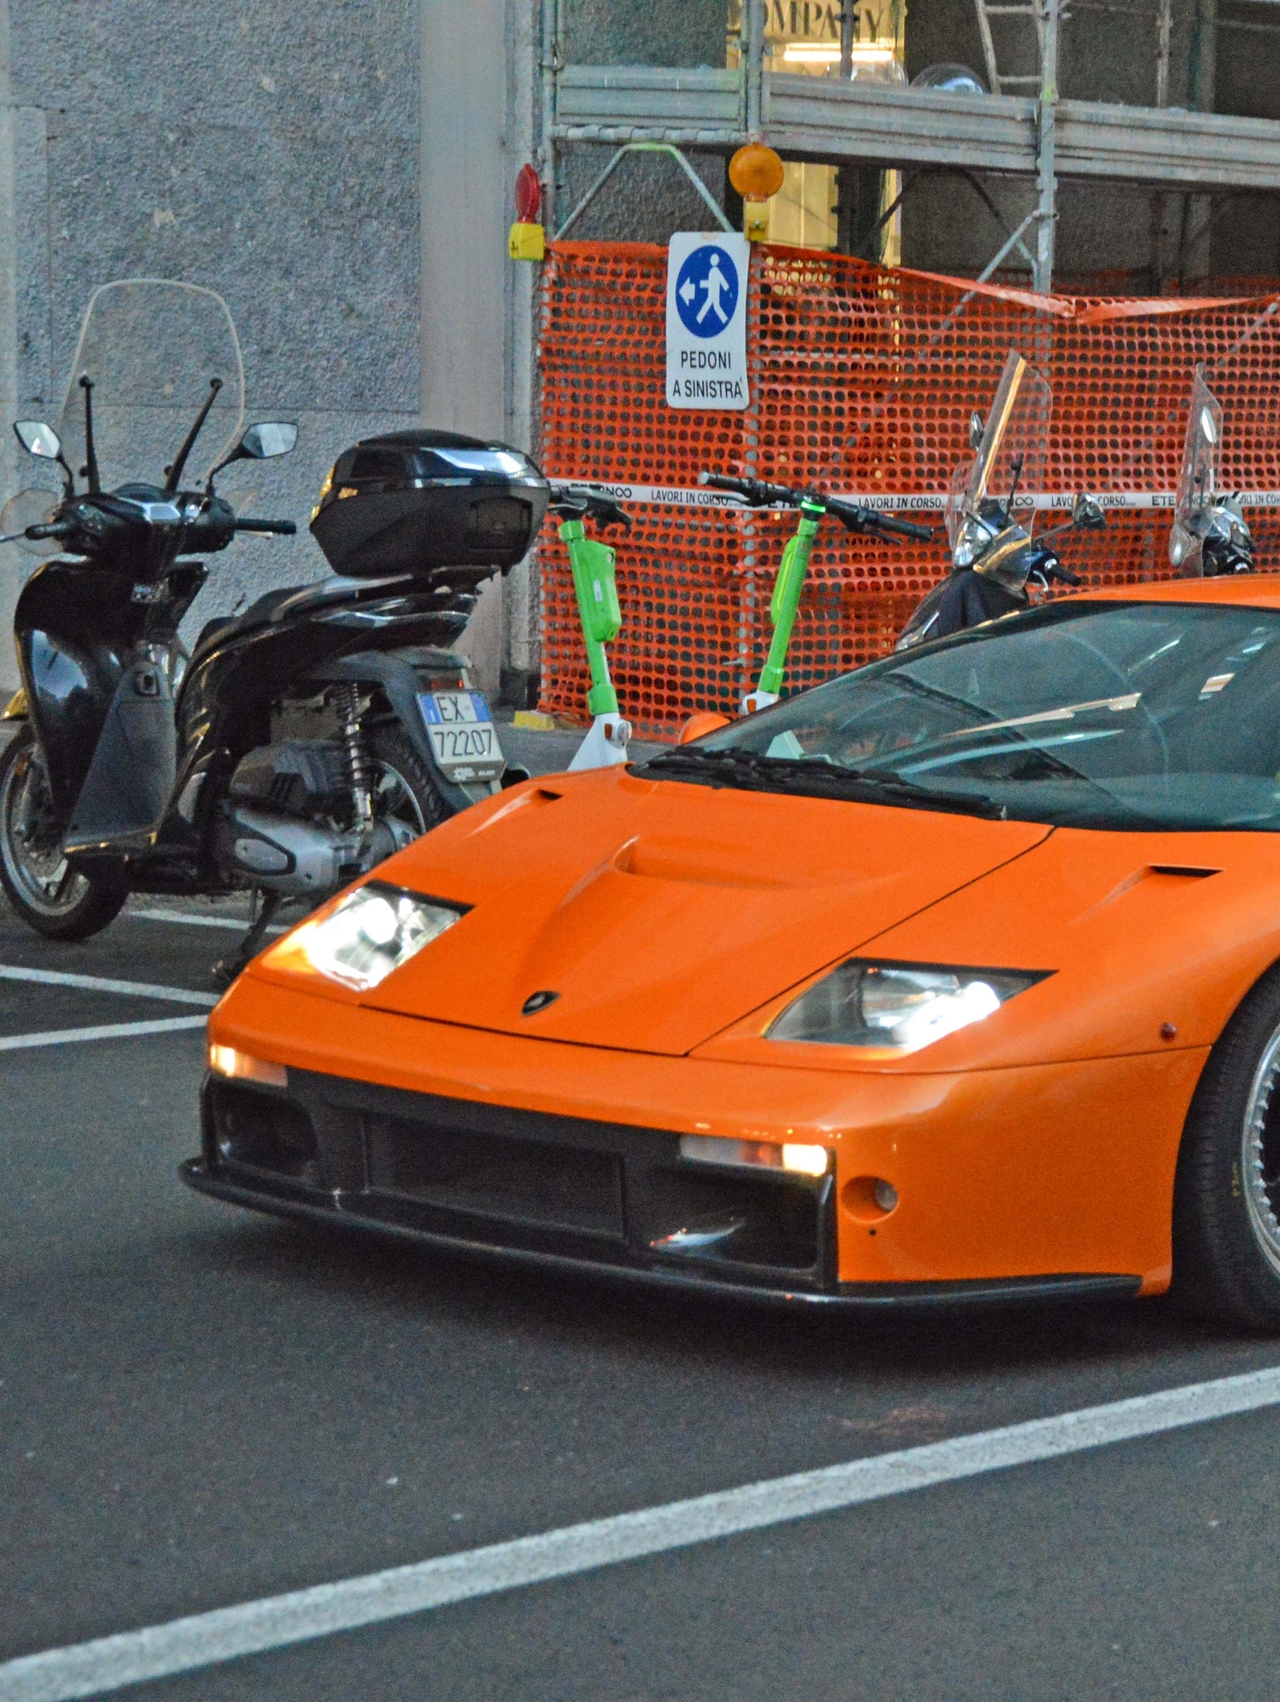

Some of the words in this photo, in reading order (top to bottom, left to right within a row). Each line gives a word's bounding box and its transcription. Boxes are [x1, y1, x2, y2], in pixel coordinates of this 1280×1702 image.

[681, 350, 731, 369] PEDONI
[673, 379, 681, 397] A
[651, 489, 683, 502] LAVORI
[686, 492, 695, 504] IN
[859, 497, 893, 508] LAVORI
[896, 497, 908, 508] IN
[910, 497, 942, 508] CORSO
[1051, 496, 1073, 507] LAVO
[1255, 494, 1264, 504] IN
[437, 695, 465, 721] EX
[434, 728, 492, 757] 72207
